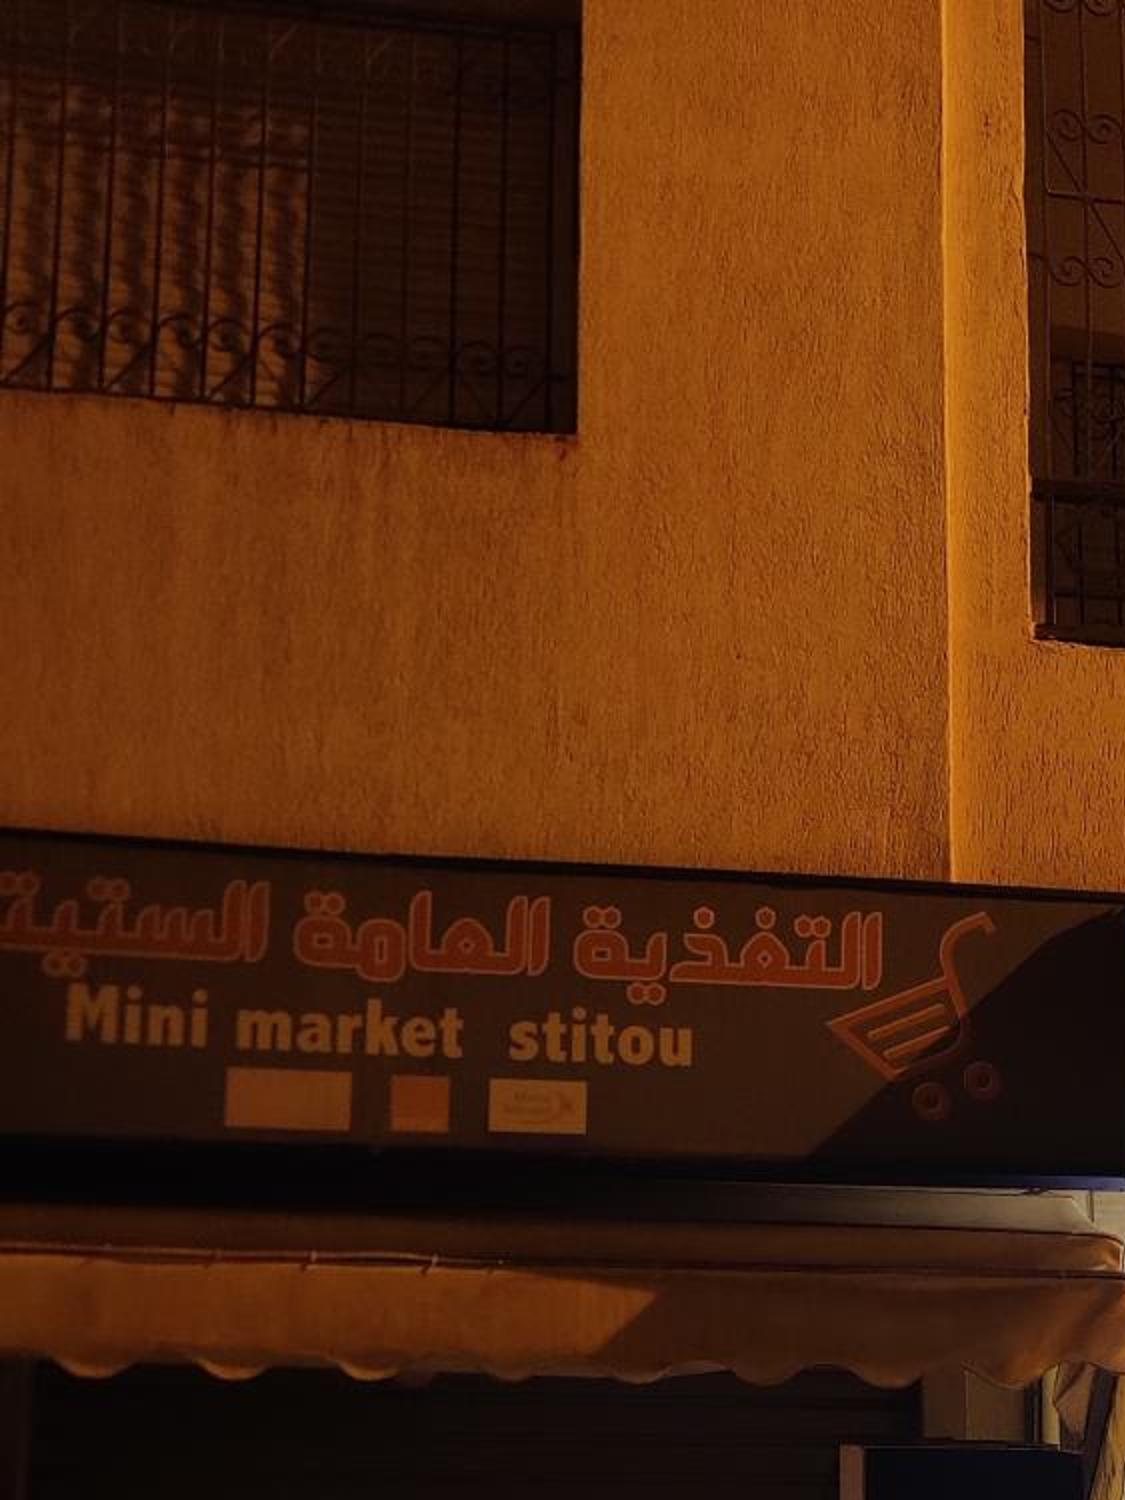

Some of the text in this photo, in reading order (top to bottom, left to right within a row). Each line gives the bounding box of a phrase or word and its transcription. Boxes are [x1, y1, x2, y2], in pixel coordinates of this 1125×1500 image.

[293, 889, 552, 983] العامة
[573, 903, 884, 1007] التغذية
[64, 981, 694, 1067] Mini market stitou
